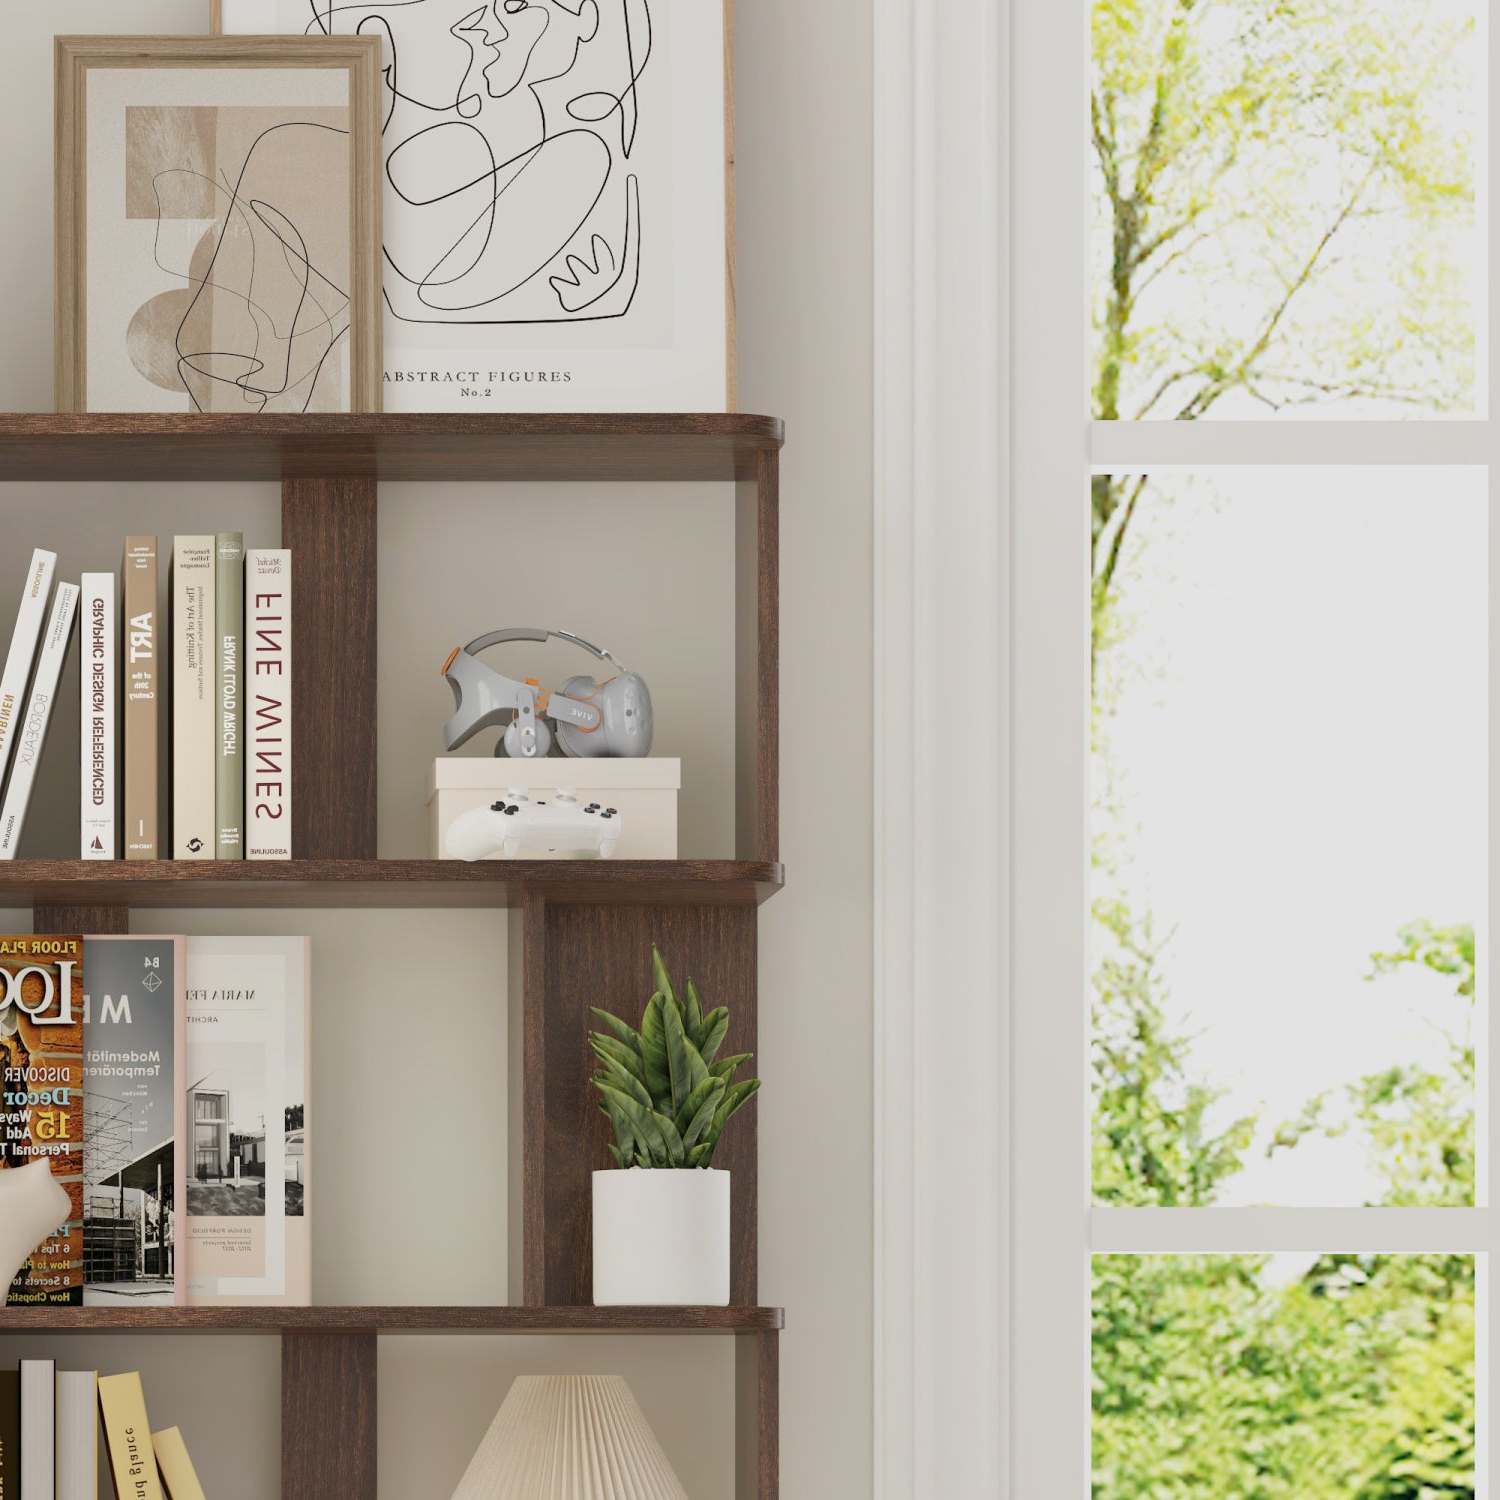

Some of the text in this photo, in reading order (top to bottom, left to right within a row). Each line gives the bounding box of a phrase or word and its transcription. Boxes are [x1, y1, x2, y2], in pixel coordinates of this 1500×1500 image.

[382, 371, 572, 382] ABSTRACT FIGURES
[460, 387, 492, 397] No.2
